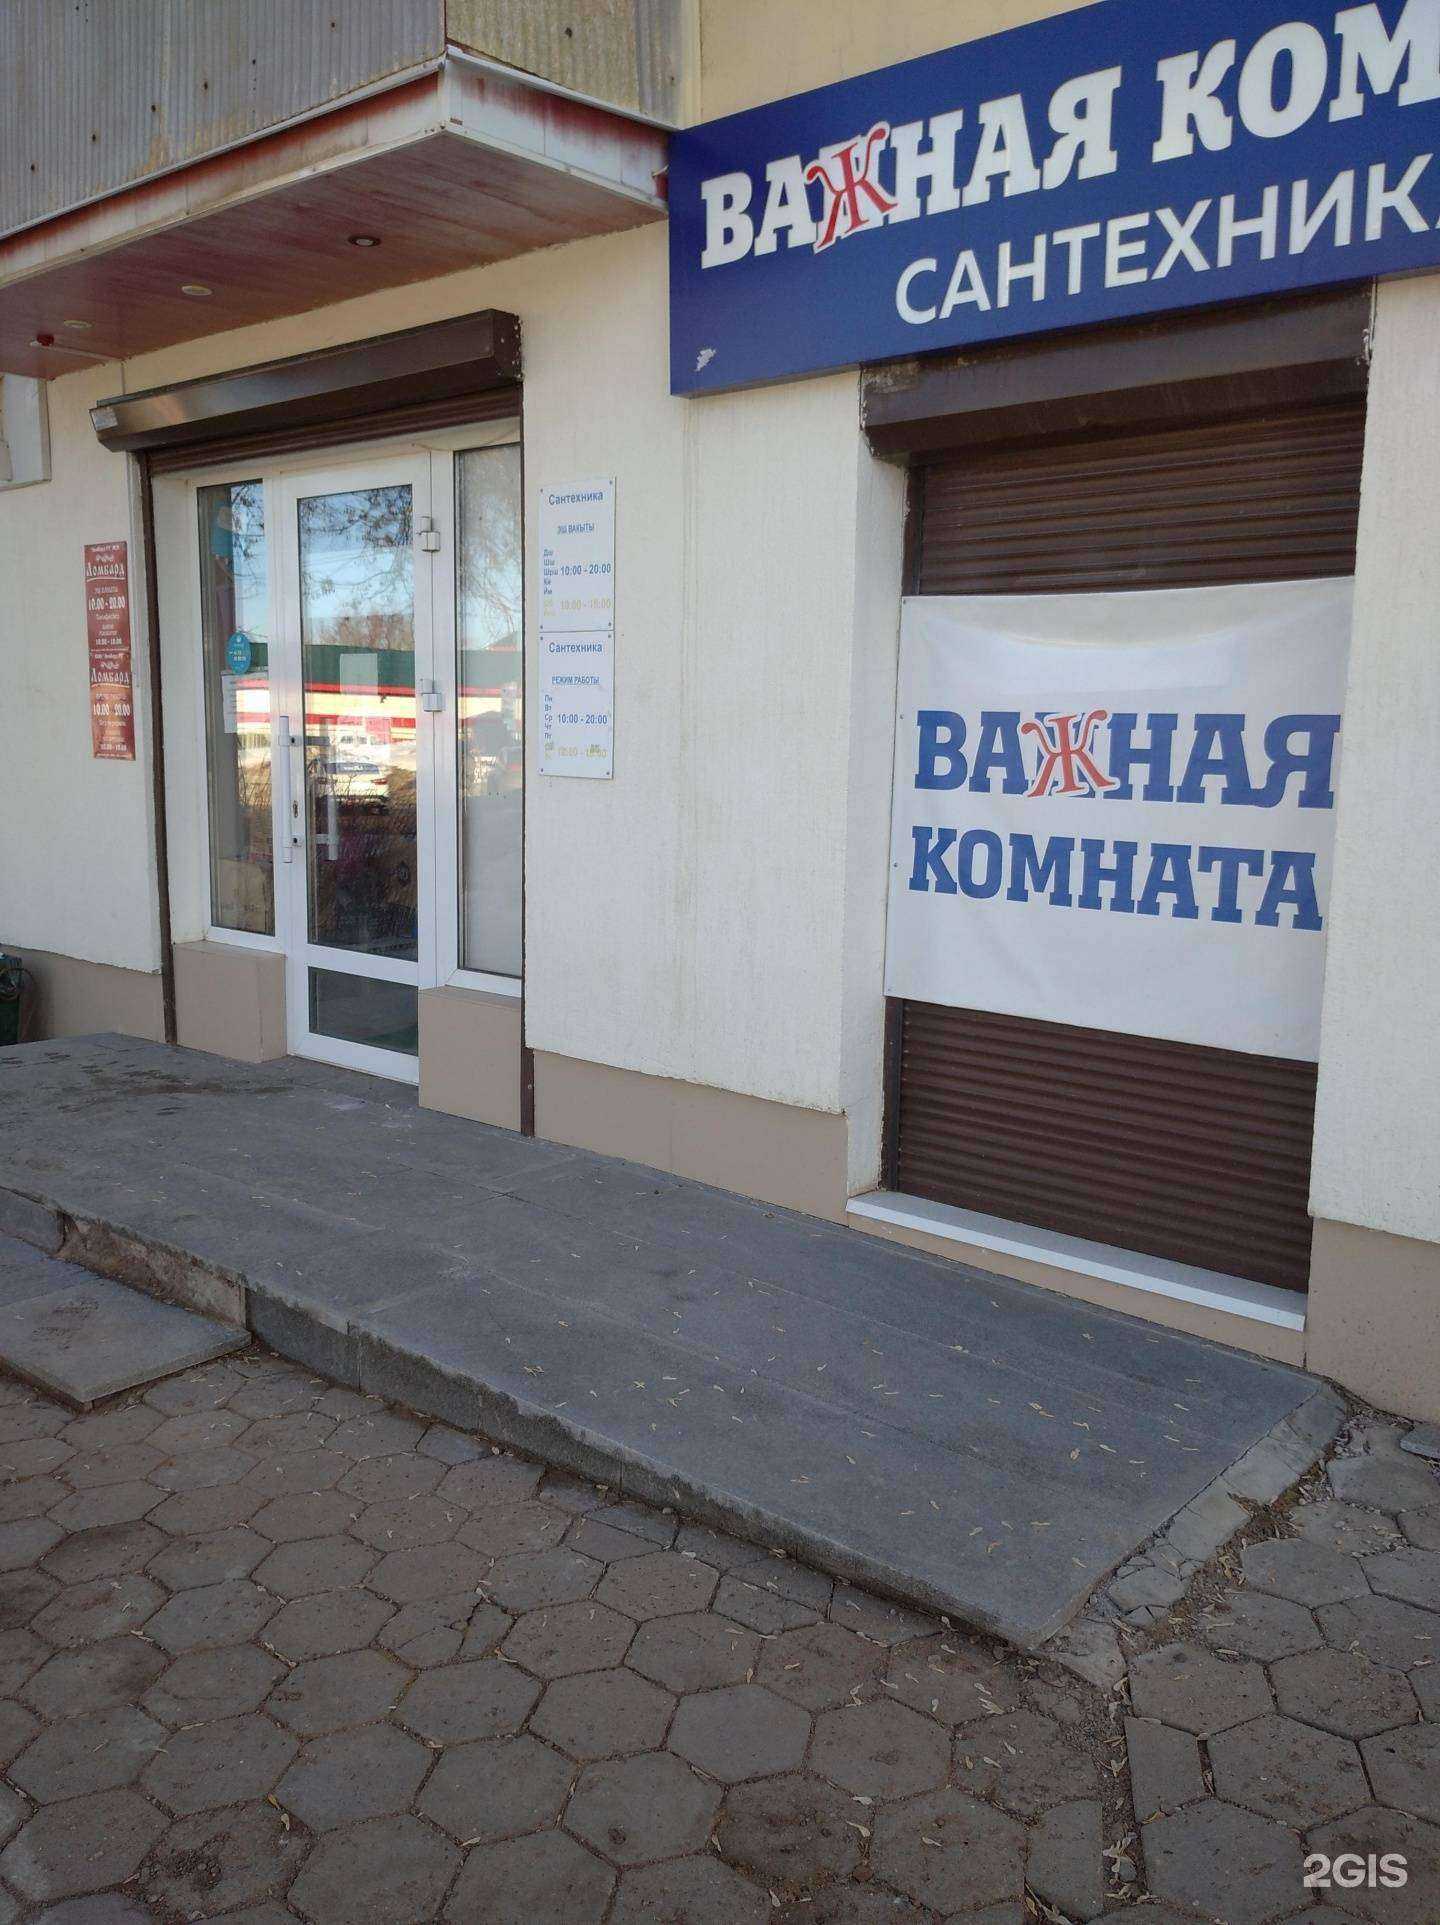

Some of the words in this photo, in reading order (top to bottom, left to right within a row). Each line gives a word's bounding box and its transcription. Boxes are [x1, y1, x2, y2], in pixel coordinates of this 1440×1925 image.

[701, 66, 1122, 270] ВАЖНАЯ
[896, 154, 1440, 325] САНТЕХНИК
[548, 491, 603, 506] Сантехника
[560, 565, 582, 576] 10:00
[589, 563, 612, 575] 20:00
[548, 641, 603, 654] Сантехника
[574, 675, 600, 685] РАБОТЫ
[558, 713, 579, 724] 10:00
[585, 714, 608, 725] 20:00
[914, 709, 1341, 809] ВАЖНАЯ
[908, 826, 1324, 932] КОМНАТА
